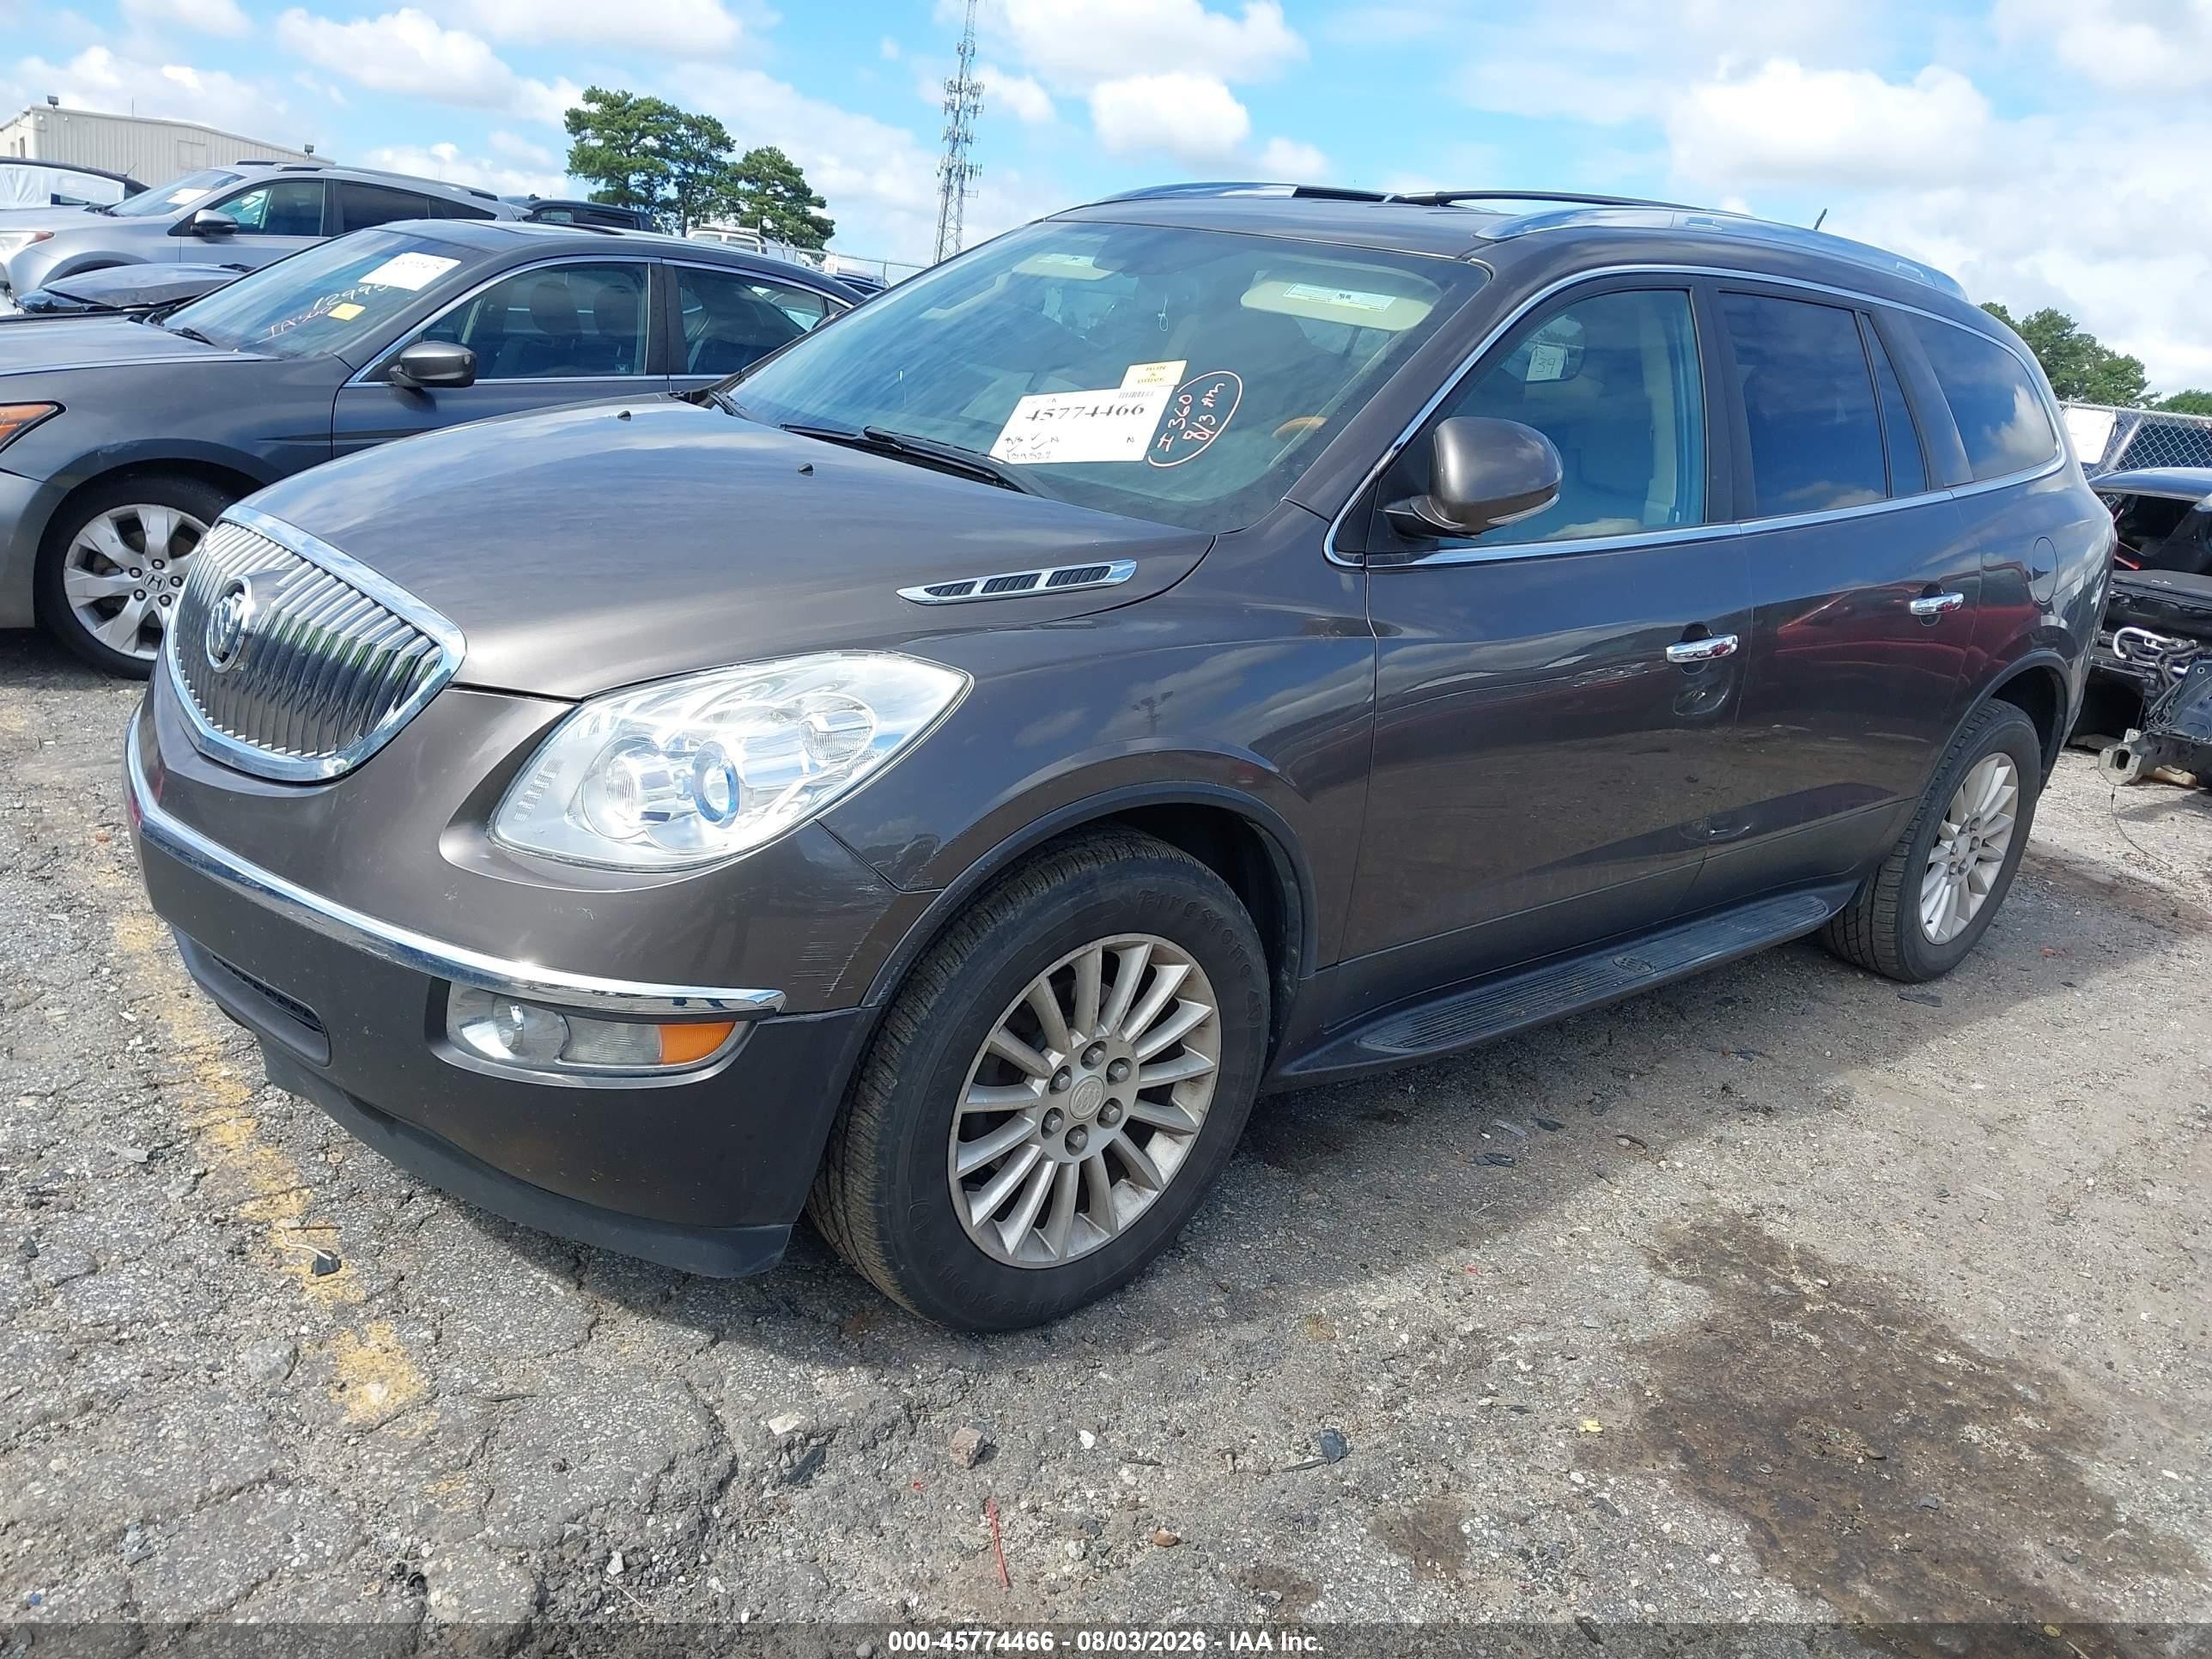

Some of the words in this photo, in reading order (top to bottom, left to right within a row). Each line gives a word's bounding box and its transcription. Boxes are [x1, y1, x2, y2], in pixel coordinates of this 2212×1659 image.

[1025, 403, 1146, 422] 45774466
[1168, 394, 1193, 430] 360
[1182, 414, 1217, 441] 8/3
[1135, 890, 1253, 980] Firestone
